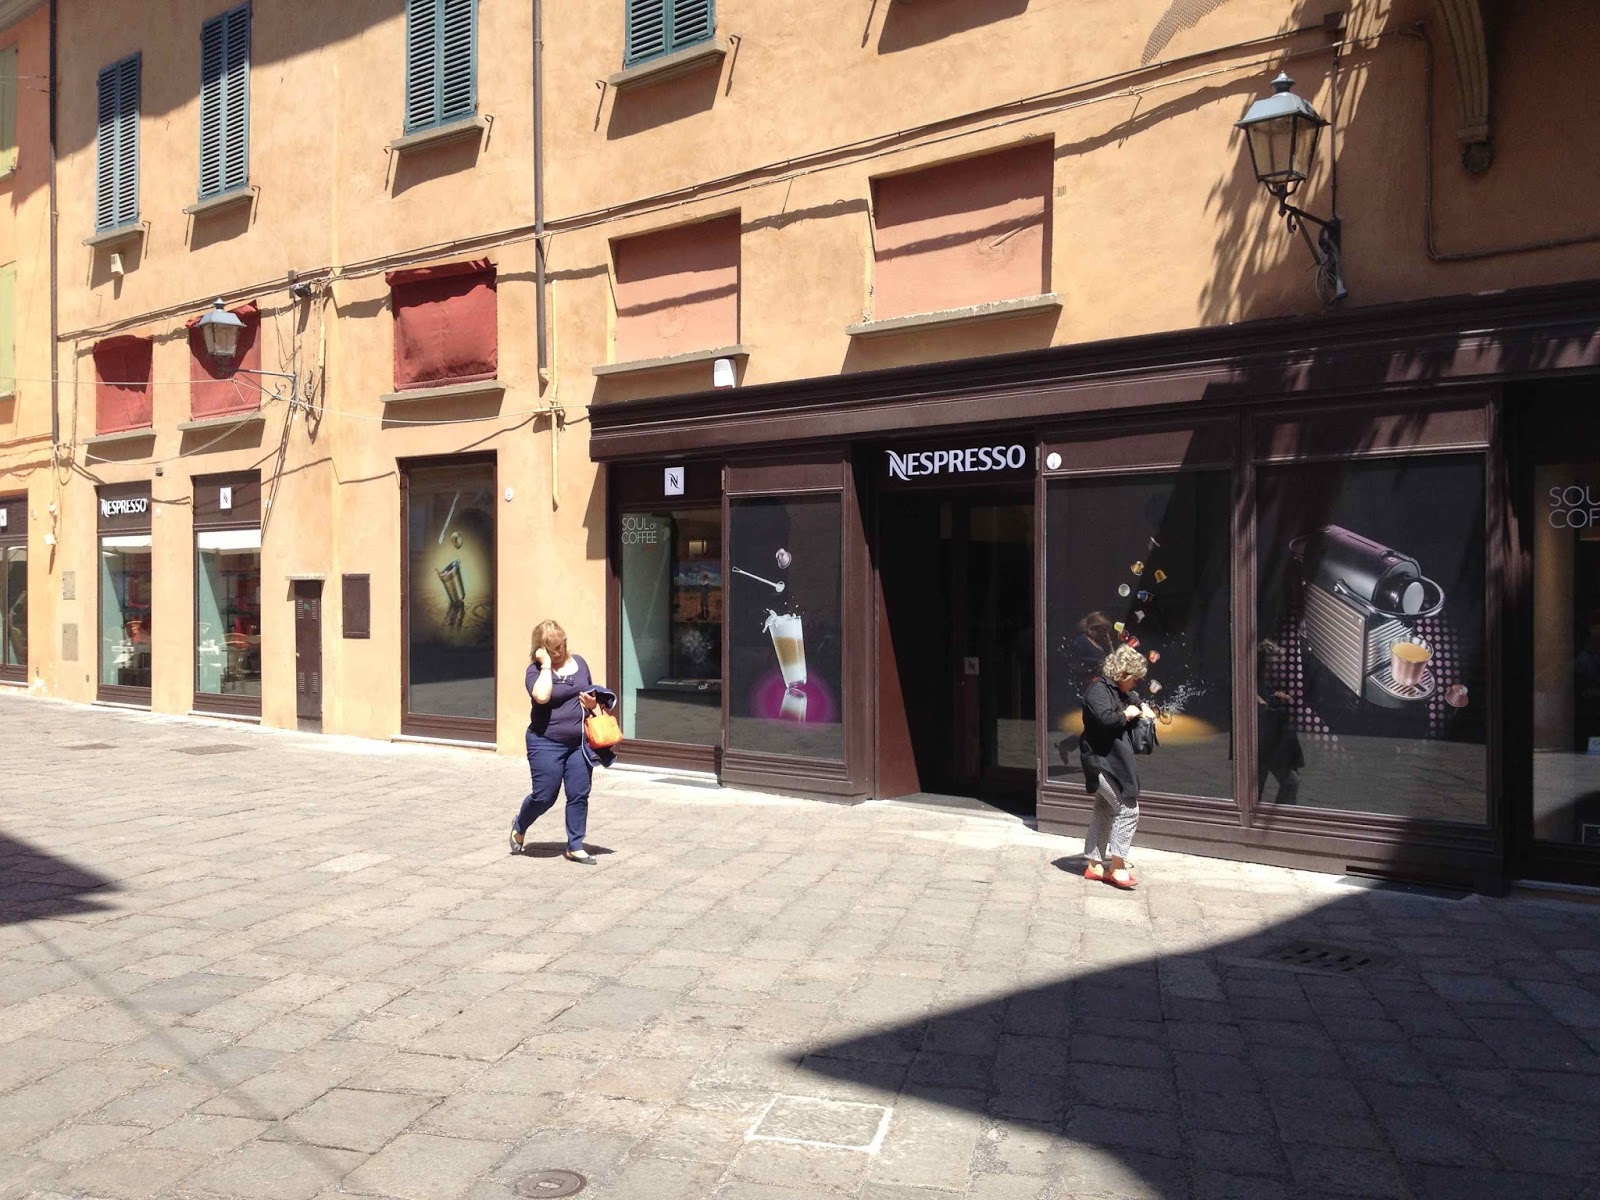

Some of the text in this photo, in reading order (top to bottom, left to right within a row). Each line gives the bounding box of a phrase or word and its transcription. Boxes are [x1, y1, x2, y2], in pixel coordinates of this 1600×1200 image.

[885, 444, 1026, 481] NESPRESSO
[100, 497, 148, 518] NESPRESSO
[621, 517, 649, 531] SOUL
[621, 531, 657, 545] COFFEE
